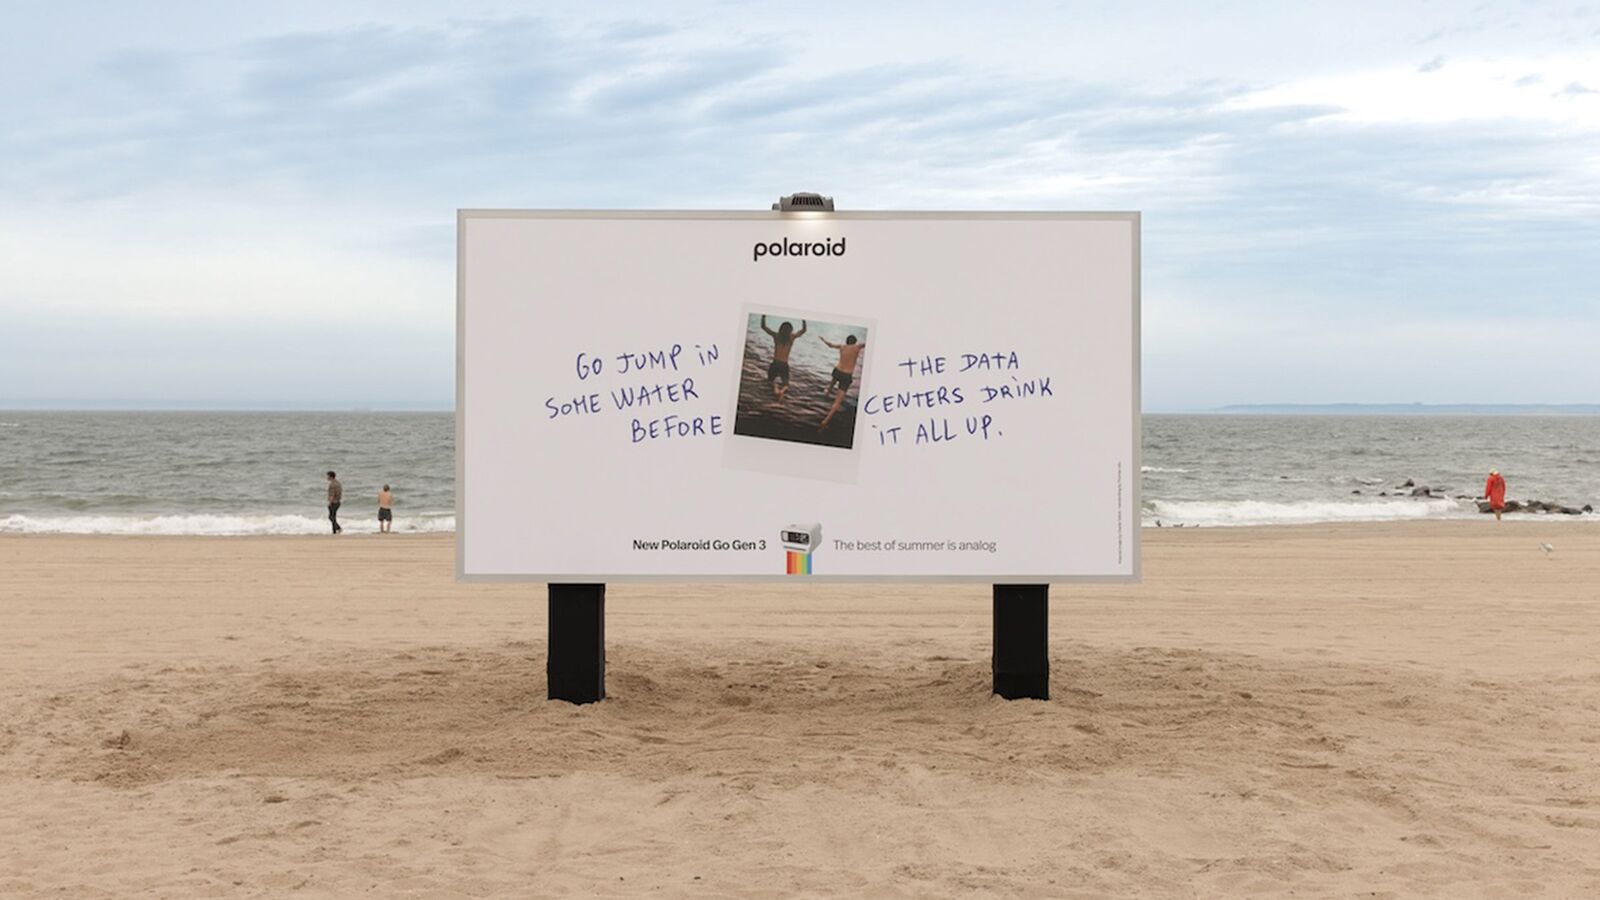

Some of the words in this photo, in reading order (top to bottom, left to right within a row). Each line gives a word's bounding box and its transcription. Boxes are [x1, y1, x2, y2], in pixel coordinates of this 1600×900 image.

[753, 236, 846, 262] polaroid
[576, 352, 603, 380] GO
[616, 343, 682, 375] JUMP
[959, 350, 1019, 373] DATA
[545, 394, 602, 419] SOME
[611, 377, 700, 411] WATER
[863, 385, 965, 416] CENTERS
[631, 414, 723, 443] BEFORE
[915, 417, 957, 445] ALL
[966, 414, 1003, 440] UP.
[633, 539, 660, 550] New
[661, 539, 710, 550] Polaroid
[712, 539, 730, 550] Go
[732, 539, 756, 551] Gen
[758, 539, 767, 550] 3
[833, 539, 854, 550] The
[857, 539, 882, 551] best
[883, 539, 896, 550] of
[898, 541, 945, 551] summer
[947, 539, 956, 550] is
[958, 539, 996, 553] analog
